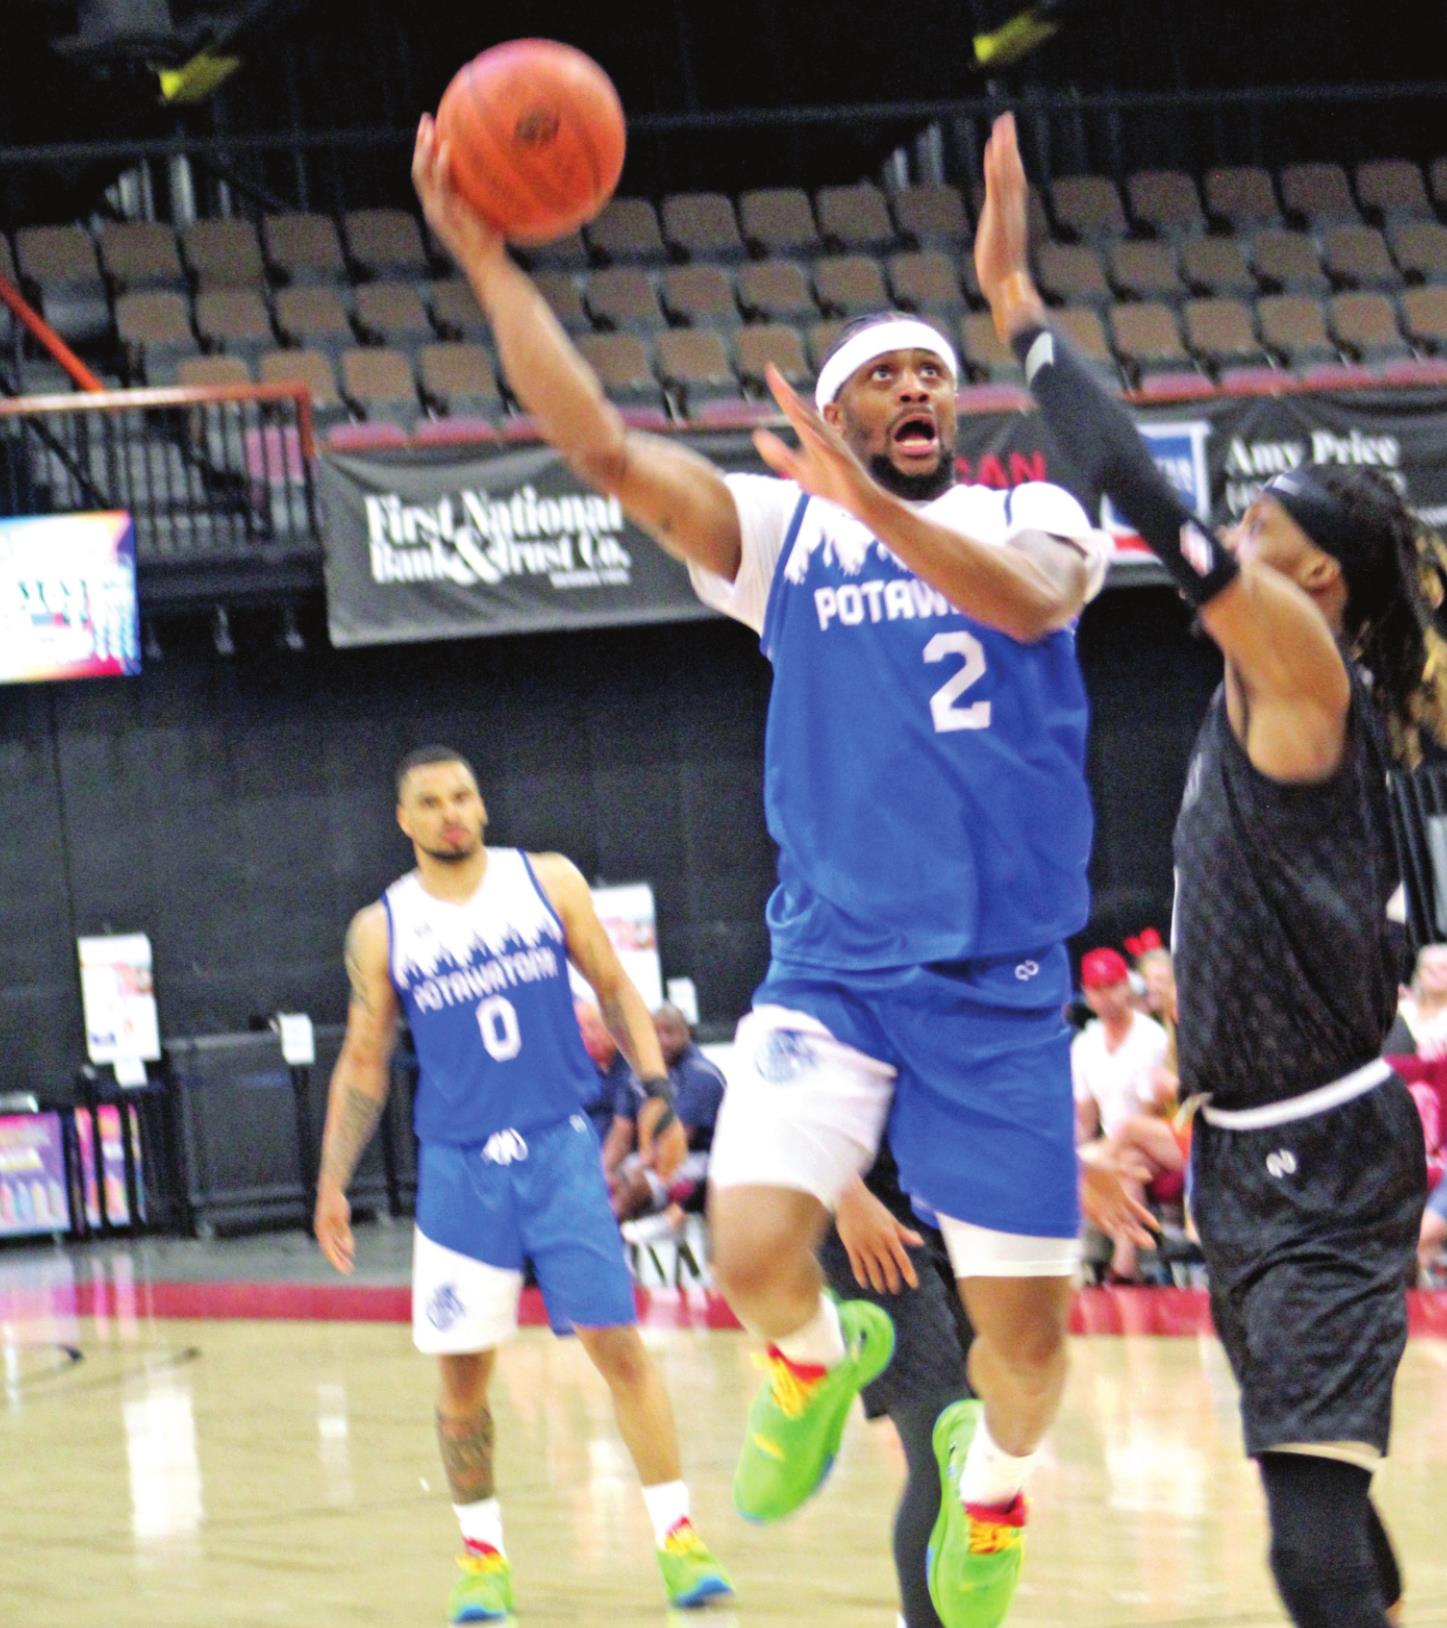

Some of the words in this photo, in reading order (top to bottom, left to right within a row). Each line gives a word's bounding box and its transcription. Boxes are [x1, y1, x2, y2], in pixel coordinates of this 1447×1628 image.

[1225, 436, 1303, 477] Amy
[1311, 429, 1401, 467] Price
[365, 493, 453, 545] First
[460, 484, 623, 540] National
[370, 538, 446, 584] Bank
[814, 578, 960, 631] POTAW
[923, 631, 991, 733] 2
[475, 994, 522, 1063] 0
